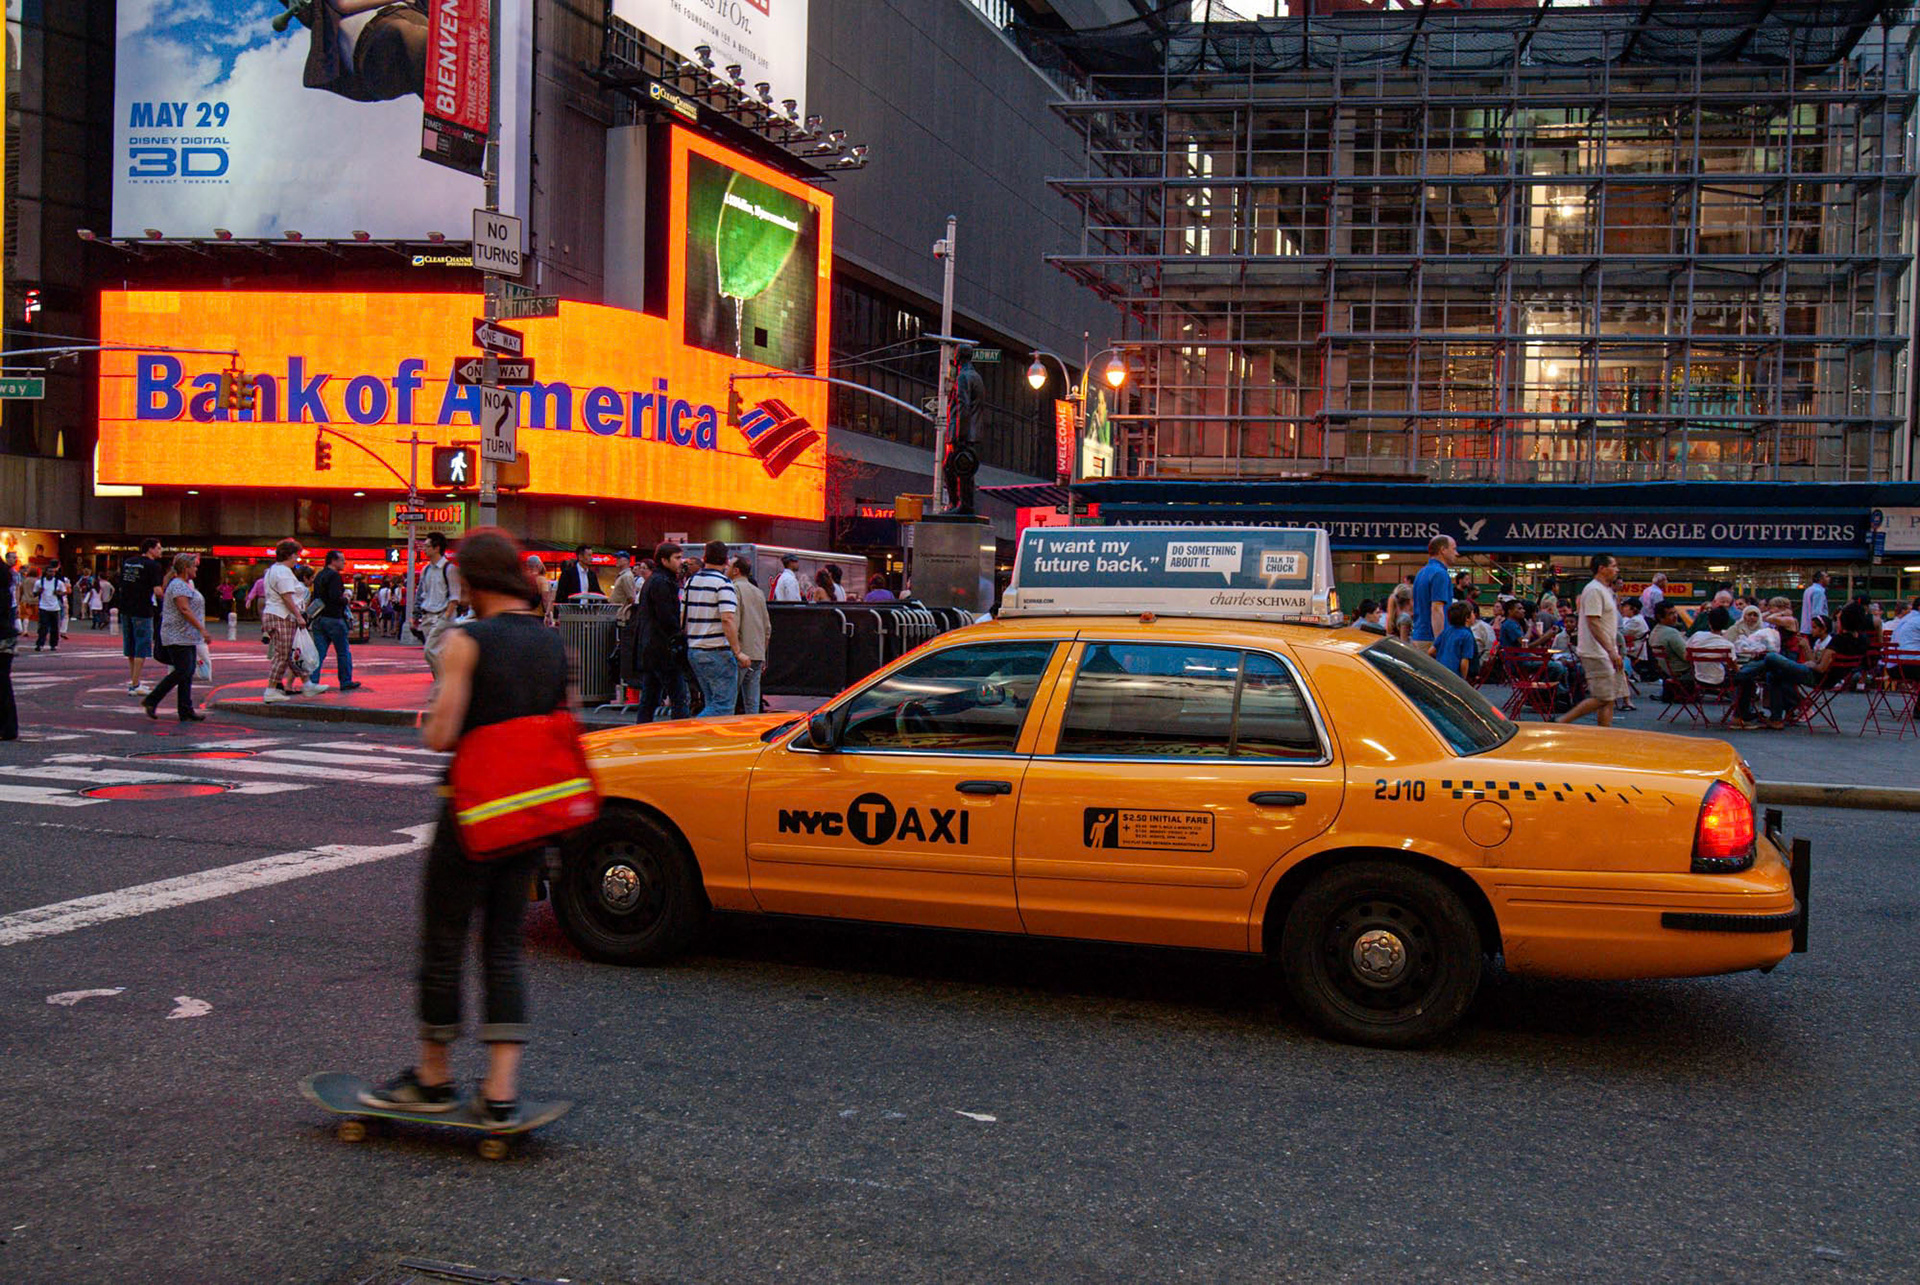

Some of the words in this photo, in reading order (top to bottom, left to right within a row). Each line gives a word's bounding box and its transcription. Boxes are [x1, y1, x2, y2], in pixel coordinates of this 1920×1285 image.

[730, 2, 752, 35] On.
[479, 21, 488, 39] OF
[683, 7, 719, 37] FOUNDATION
[738, 43, 756, 61] BETTER
[758, 56, 769, 70] LIFE
[468, 26, 479, 78] SQUARE
[477, 41, 488, 125] CROSSROADS
[467, 82, 478, 121] TIMES
[129, 102, 189, 128] MAY
[195, 102, 230, 128] 29
[129, 136, 178, 145] DISNEY
[181, 136, 230, 145] DIGITAL
[129, 147, 230, 177] 3D
[487, 221, 508, 240] NO
[476, 243, 519, 266] TURNS
[512, 299, 543, 317] TIMES
[481, 328, 497, 343] ONE
[502, 336, 518, 349] WAY
[466, 365, 482, 377] ON
[499, 366, 524, 377] WAY
[136, 355, 329, 423] Bank
[344, 358, 425, 425] of
[437, 364, 717, 450] America
[484, 391, 500, 409] NO
[485, 438, 512, 455] TURN
[1058, 405, 1067, 471] WELCOME
[1505, 522, 1627, 539] AMERICAN
[1634, 523, 1706, 540] EAGLE
[1711, 523, 1855, 541] OUTFITTERS
[1050, 539, 1096, 554] want
[1101, 541, 1130, 556] my
[1171, 545, 1184, 556] DO
[1186, 545, 1237, 556] SOMETHING
[1034, 557, 1090, 573] future
[1096, 556, 1160, 573] back.”
[1170, 557, 1199, 568] ABOUT
[1200, 557, 1211, 568] IT.
[1265, 564, 1294, 573] CHUCK
[1266, 556, 1284, 564] TALK
[1286, 556, 1295, 564] TO
[1210, 591, 1255, 606] charles
[1256, 596, 1306, 607] SCHWAB
[1375, 779, 1425, 802] 2J10
[778, 809, 843, 836] NYC
[856, 802, 969, 845] TAXI
[1122, 813, 1147, 822] $2.50
[1149, 814, 1182, 824] INITIAL
[1185, 816, 1209, 825] FARE
